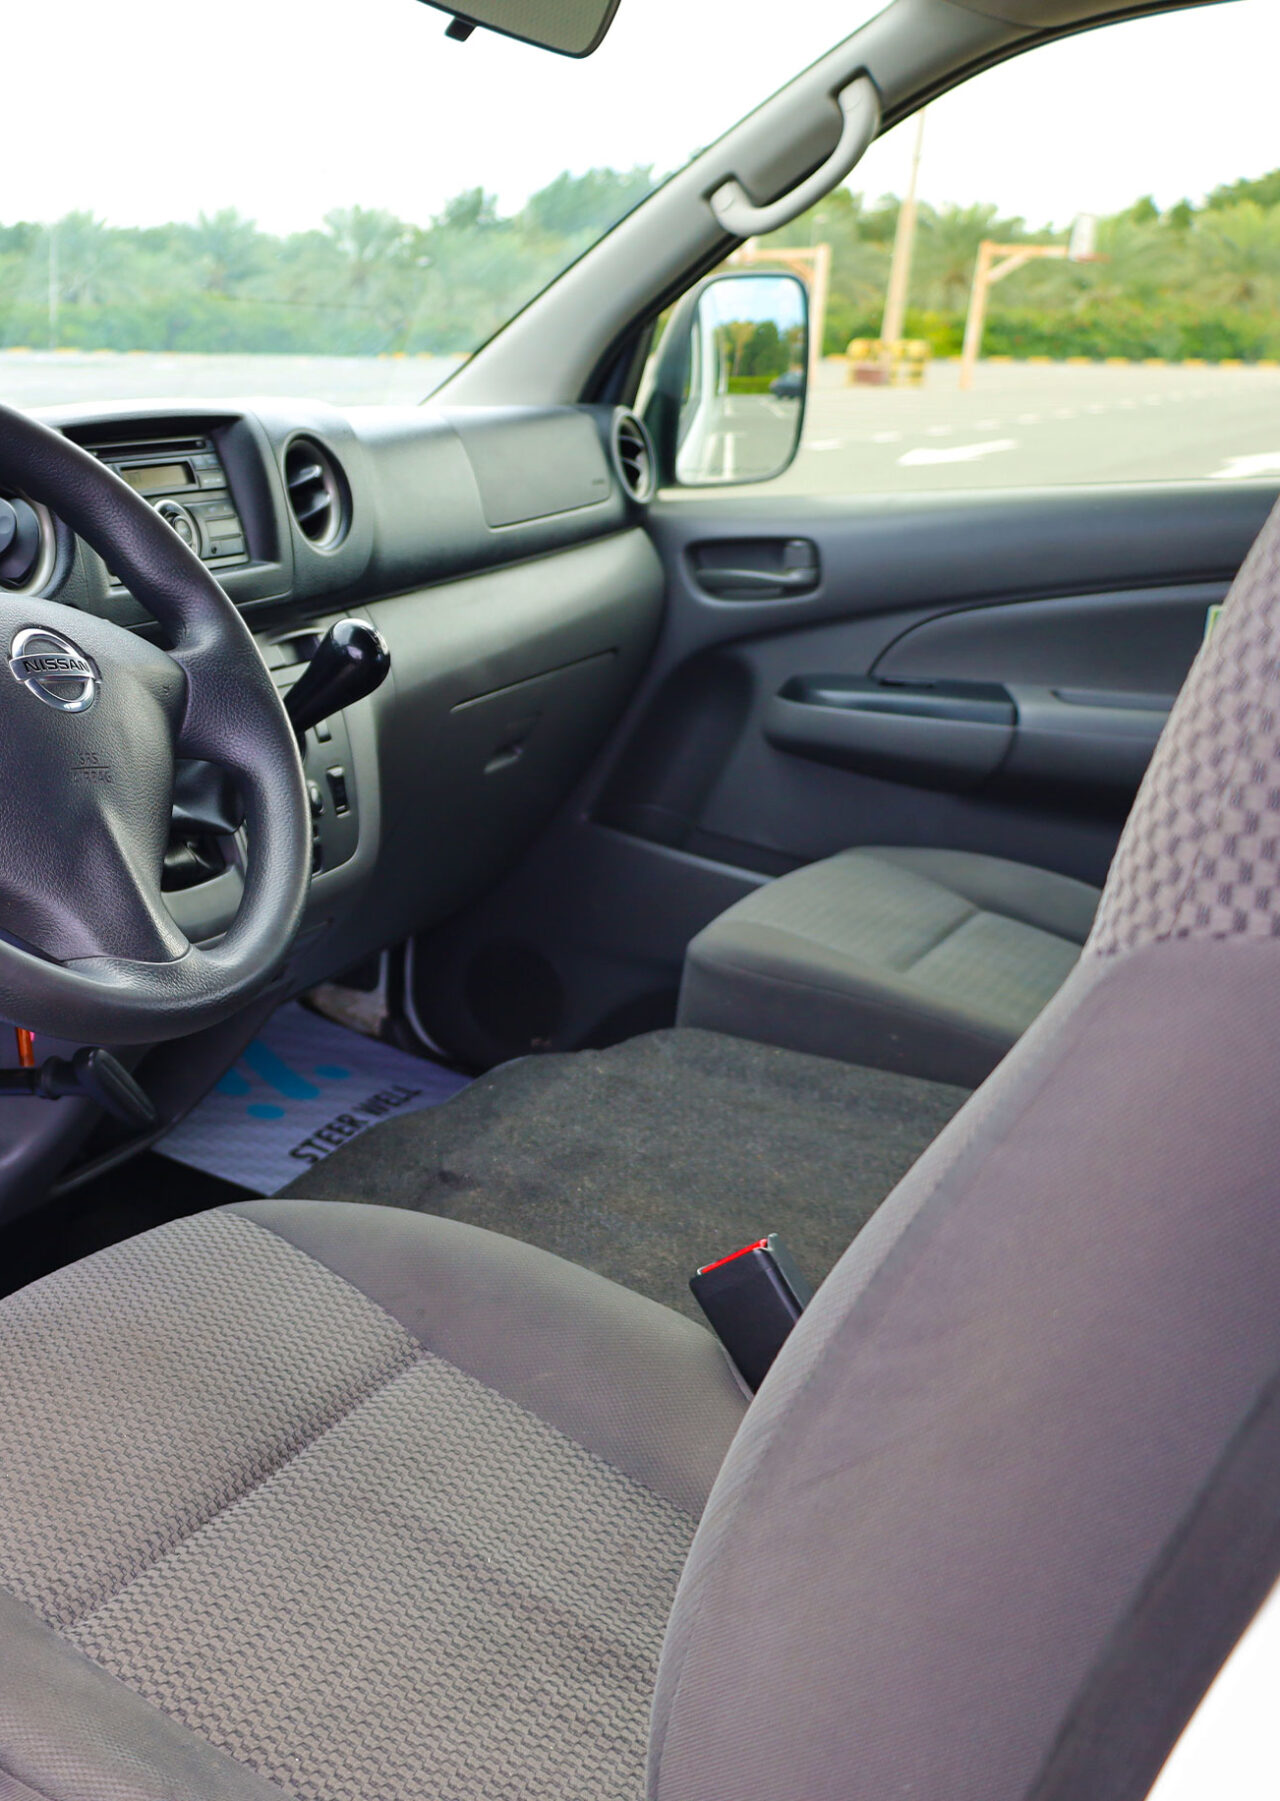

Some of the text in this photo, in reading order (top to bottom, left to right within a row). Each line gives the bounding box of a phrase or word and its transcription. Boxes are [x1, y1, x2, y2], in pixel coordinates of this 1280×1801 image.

[22, 659, 90, 674] NISSAN
[289, 1084, 421, 1165] STEER WELL
